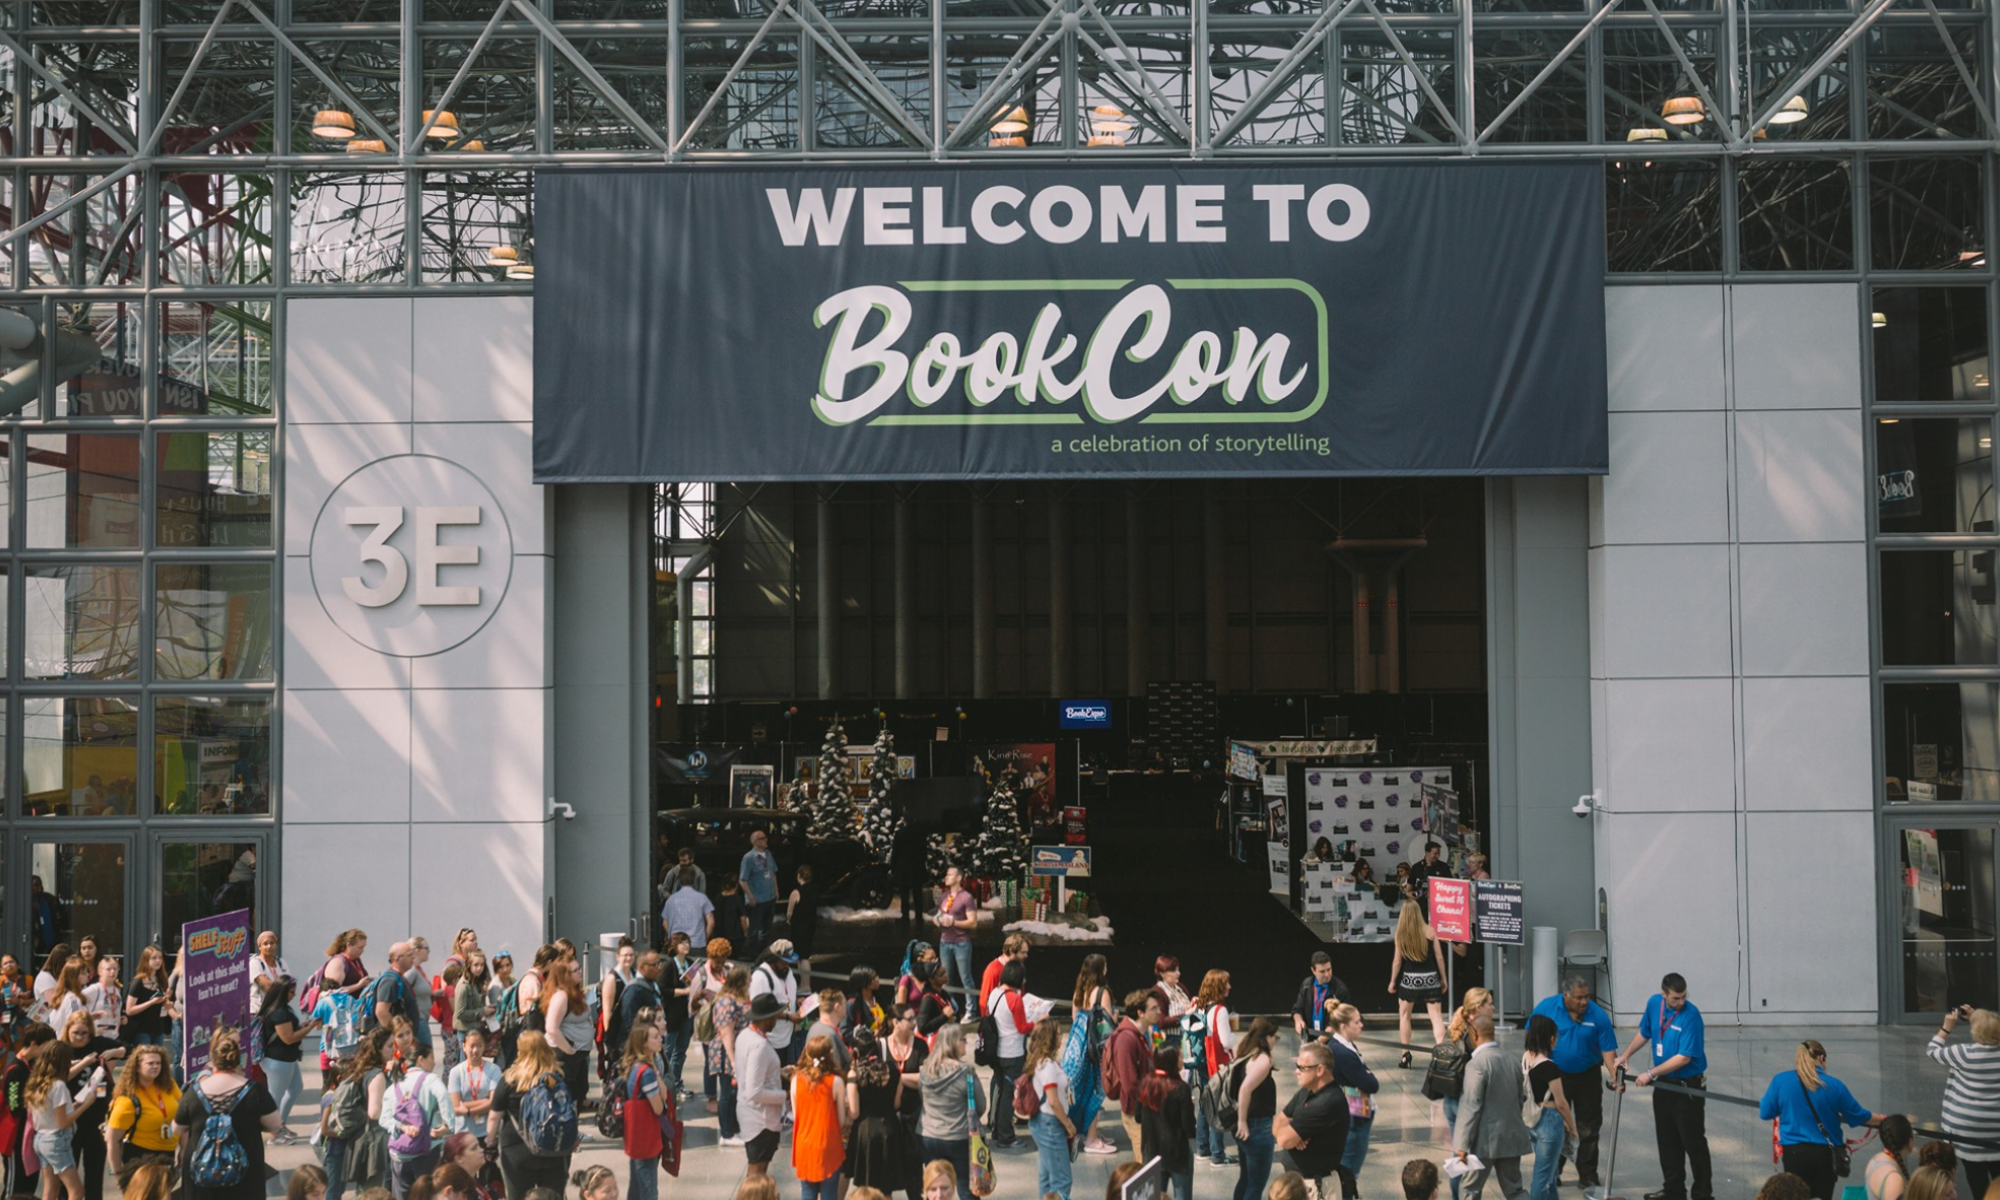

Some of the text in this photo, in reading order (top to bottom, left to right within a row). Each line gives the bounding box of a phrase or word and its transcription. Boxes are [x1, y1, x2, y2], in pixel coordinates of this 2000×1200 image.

[766, 182, 1370, 247] WELCOME TO
[811, 284, 1308, 426] BookCon
[1051, 433, 1331, 457] a celebration of storytelling
[341, 506, 482, 608] 3E
[1434, 882, 1463, 895] Happy
[1478, 893, 1522, 903] AUTOGRAPHING
[1488, 902, 1511, 910] TICKETS
[190, 930, 218, 953] SHELF
[189, 959, 247, 987] Look at this shelf.
[198, 978, 239, 1001] Isn't it neat?
